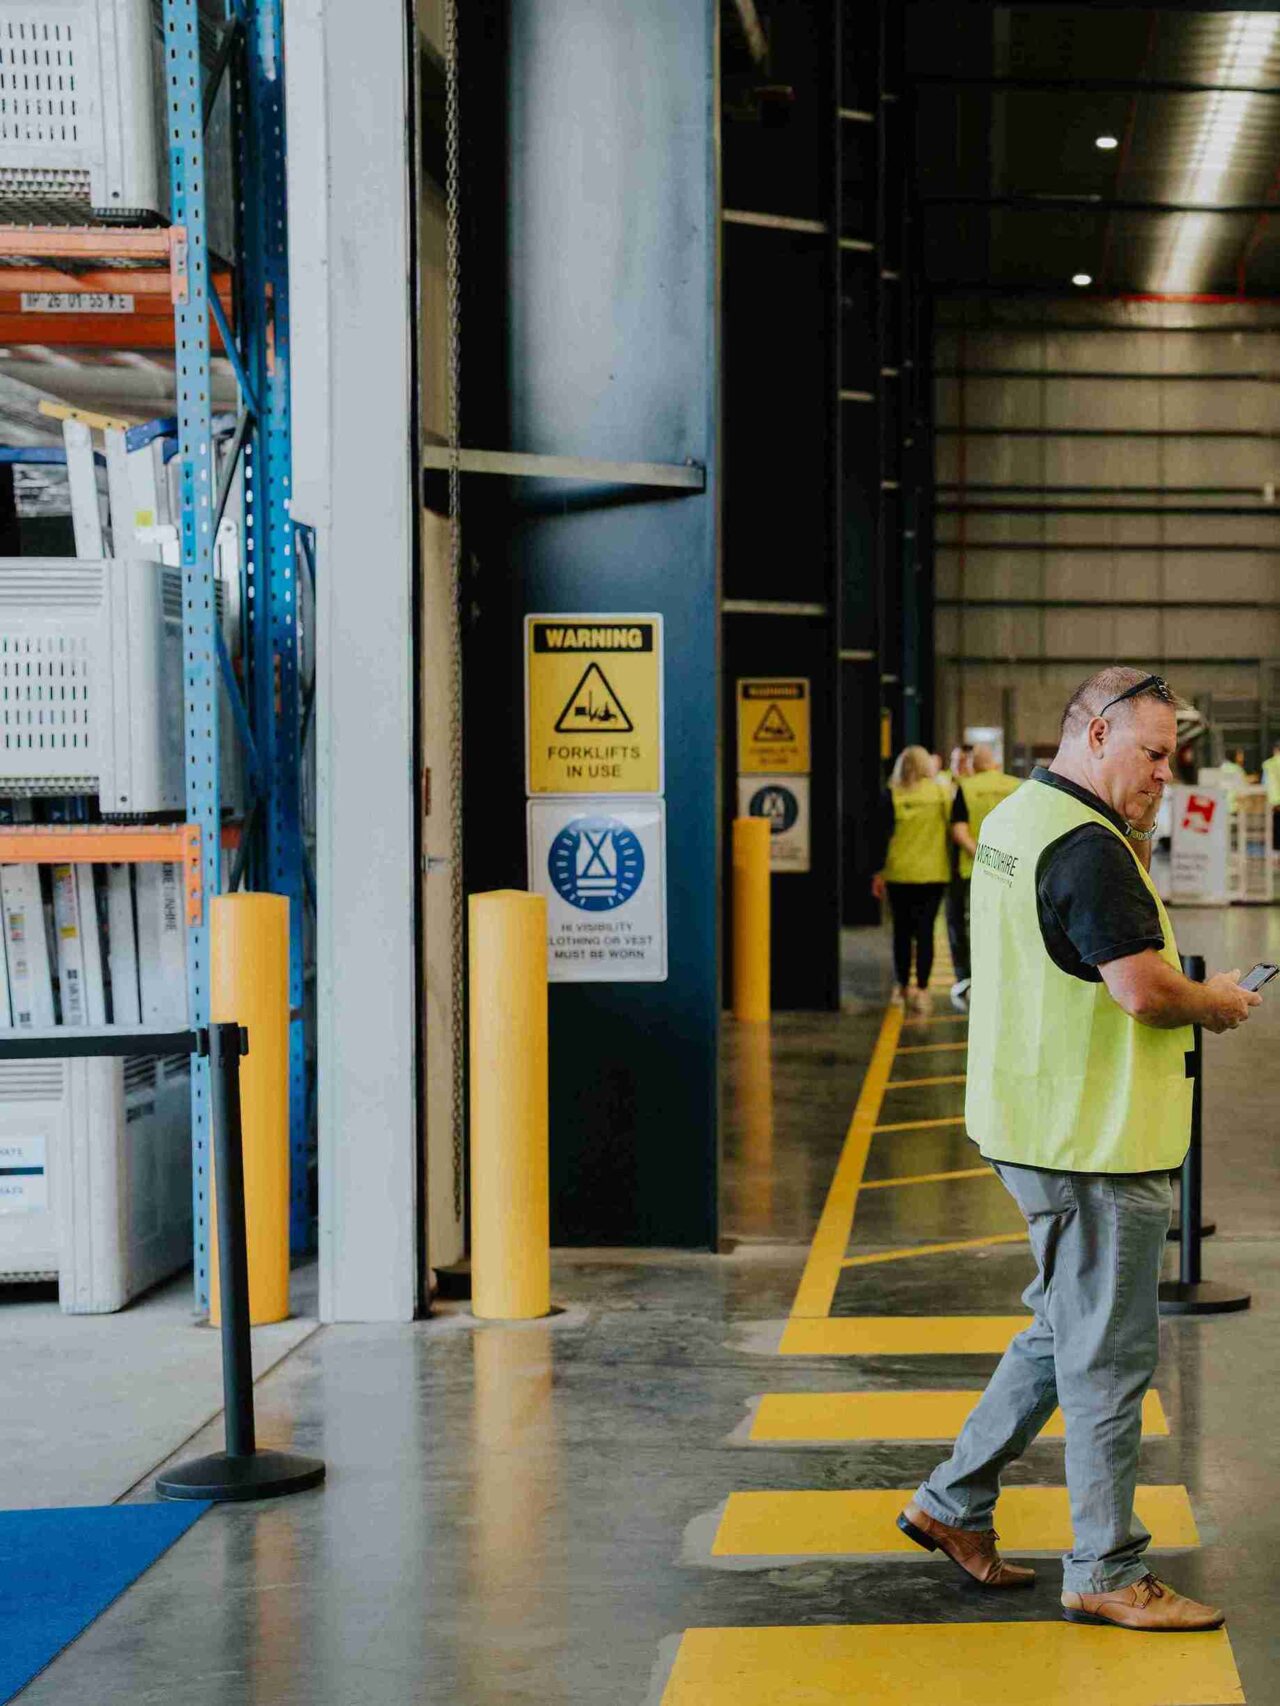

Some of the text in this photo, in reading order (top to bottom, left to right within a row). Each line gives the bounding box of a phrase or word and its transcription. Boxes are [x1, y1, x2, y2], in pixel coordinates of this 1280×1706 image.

[545, 627, 643, 649] WARNING
[547, 745, 641, 760] FORKLIFTS
[566, 764, 622, 778] IN USE
[561, 921, 633, 932] HI VISIBILITY
[547, 934, 653, 946] LOTHING OR VEST
[554, 949, 646, 960] MUST BE WORN
